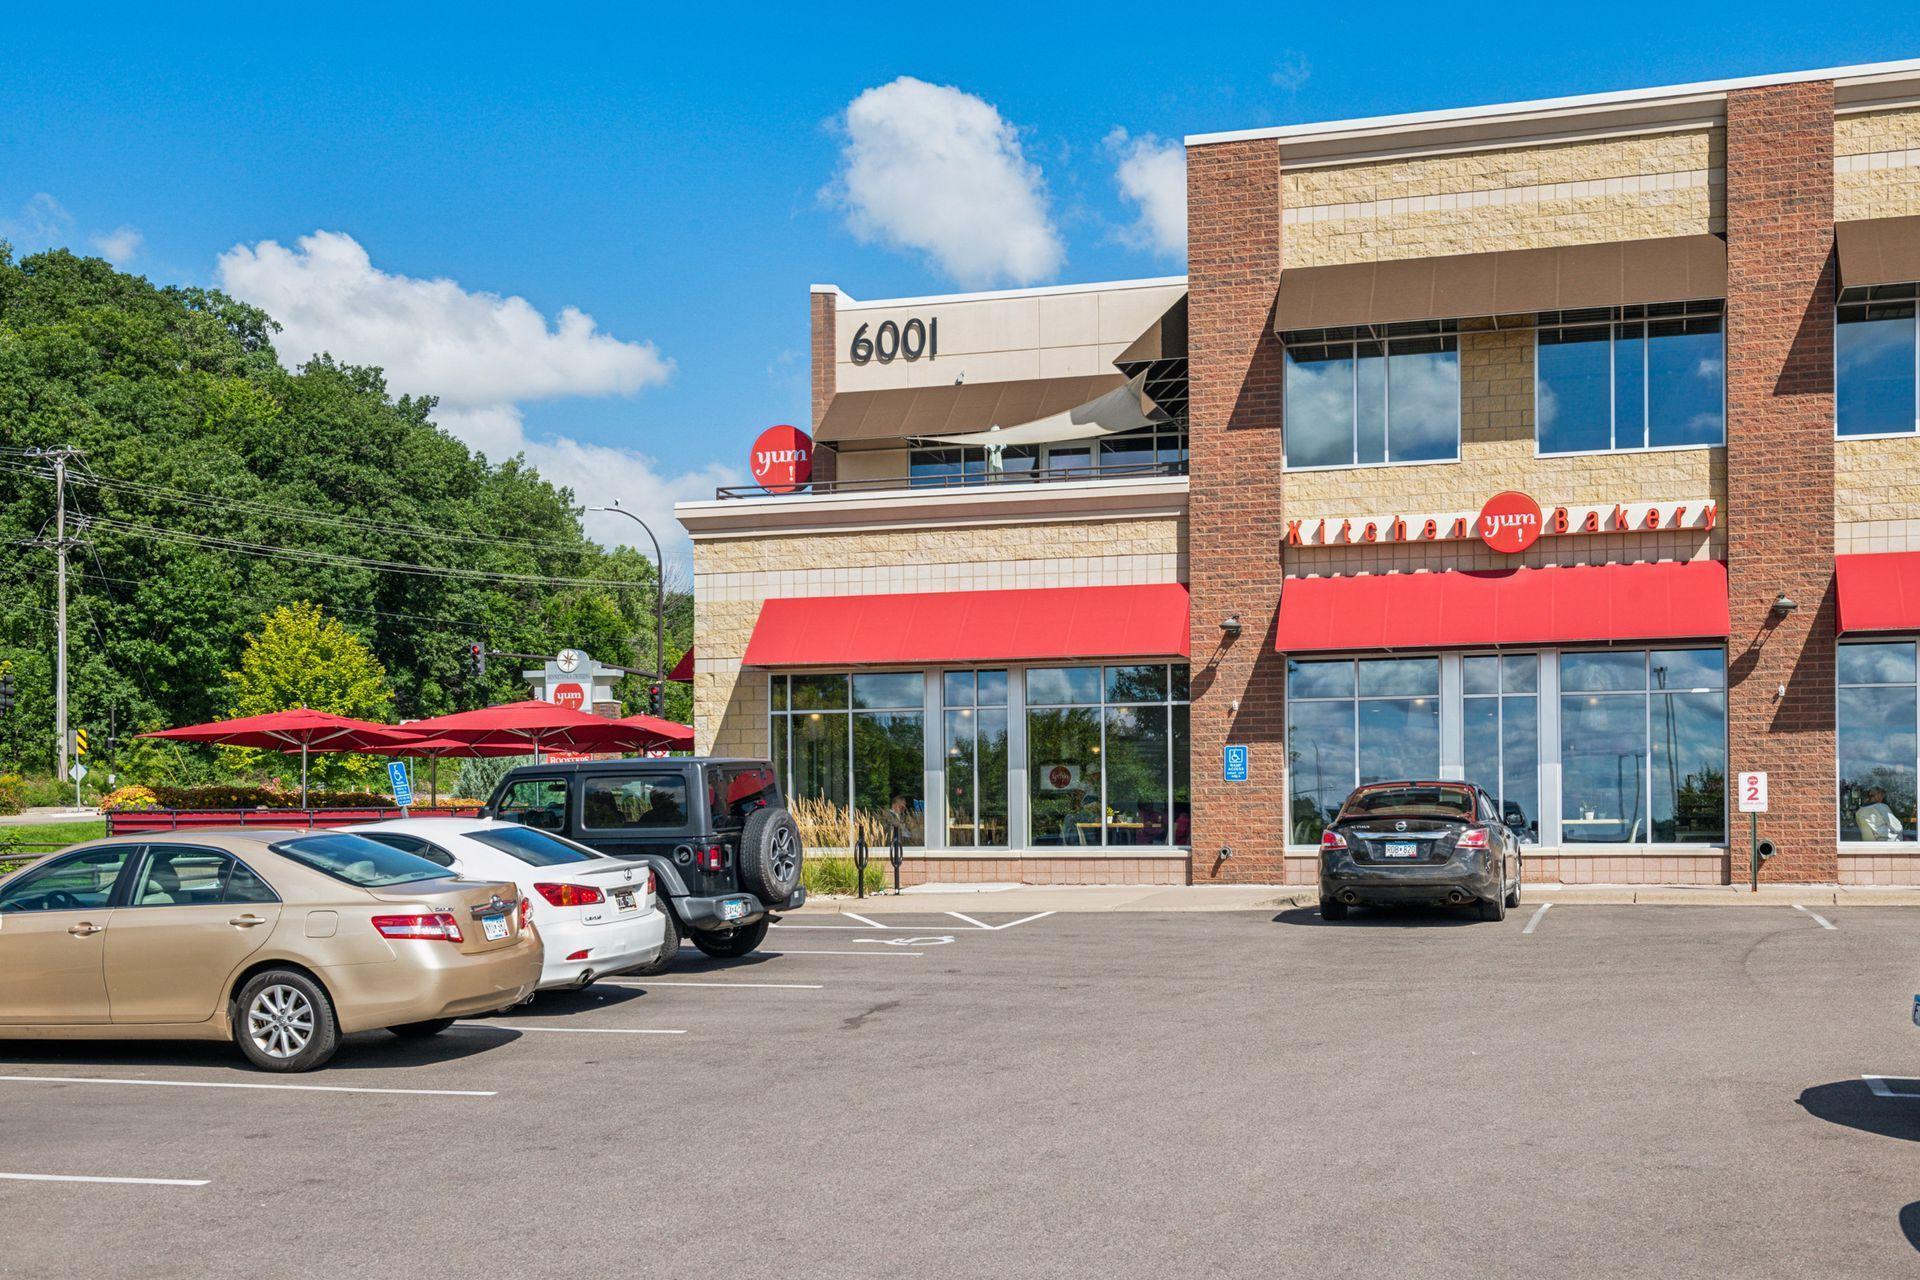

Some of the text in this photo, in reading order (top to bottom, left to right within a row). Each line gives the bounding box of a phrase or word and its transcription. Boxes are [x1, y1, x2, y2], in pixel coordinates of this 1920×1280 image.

[850, 317, 938, 364] 6001
[1287, 515, 1467, 545] Kitchen
[1555, 503, 1718, 533] Bakery
[1747, 787, 1759, 800] 2
